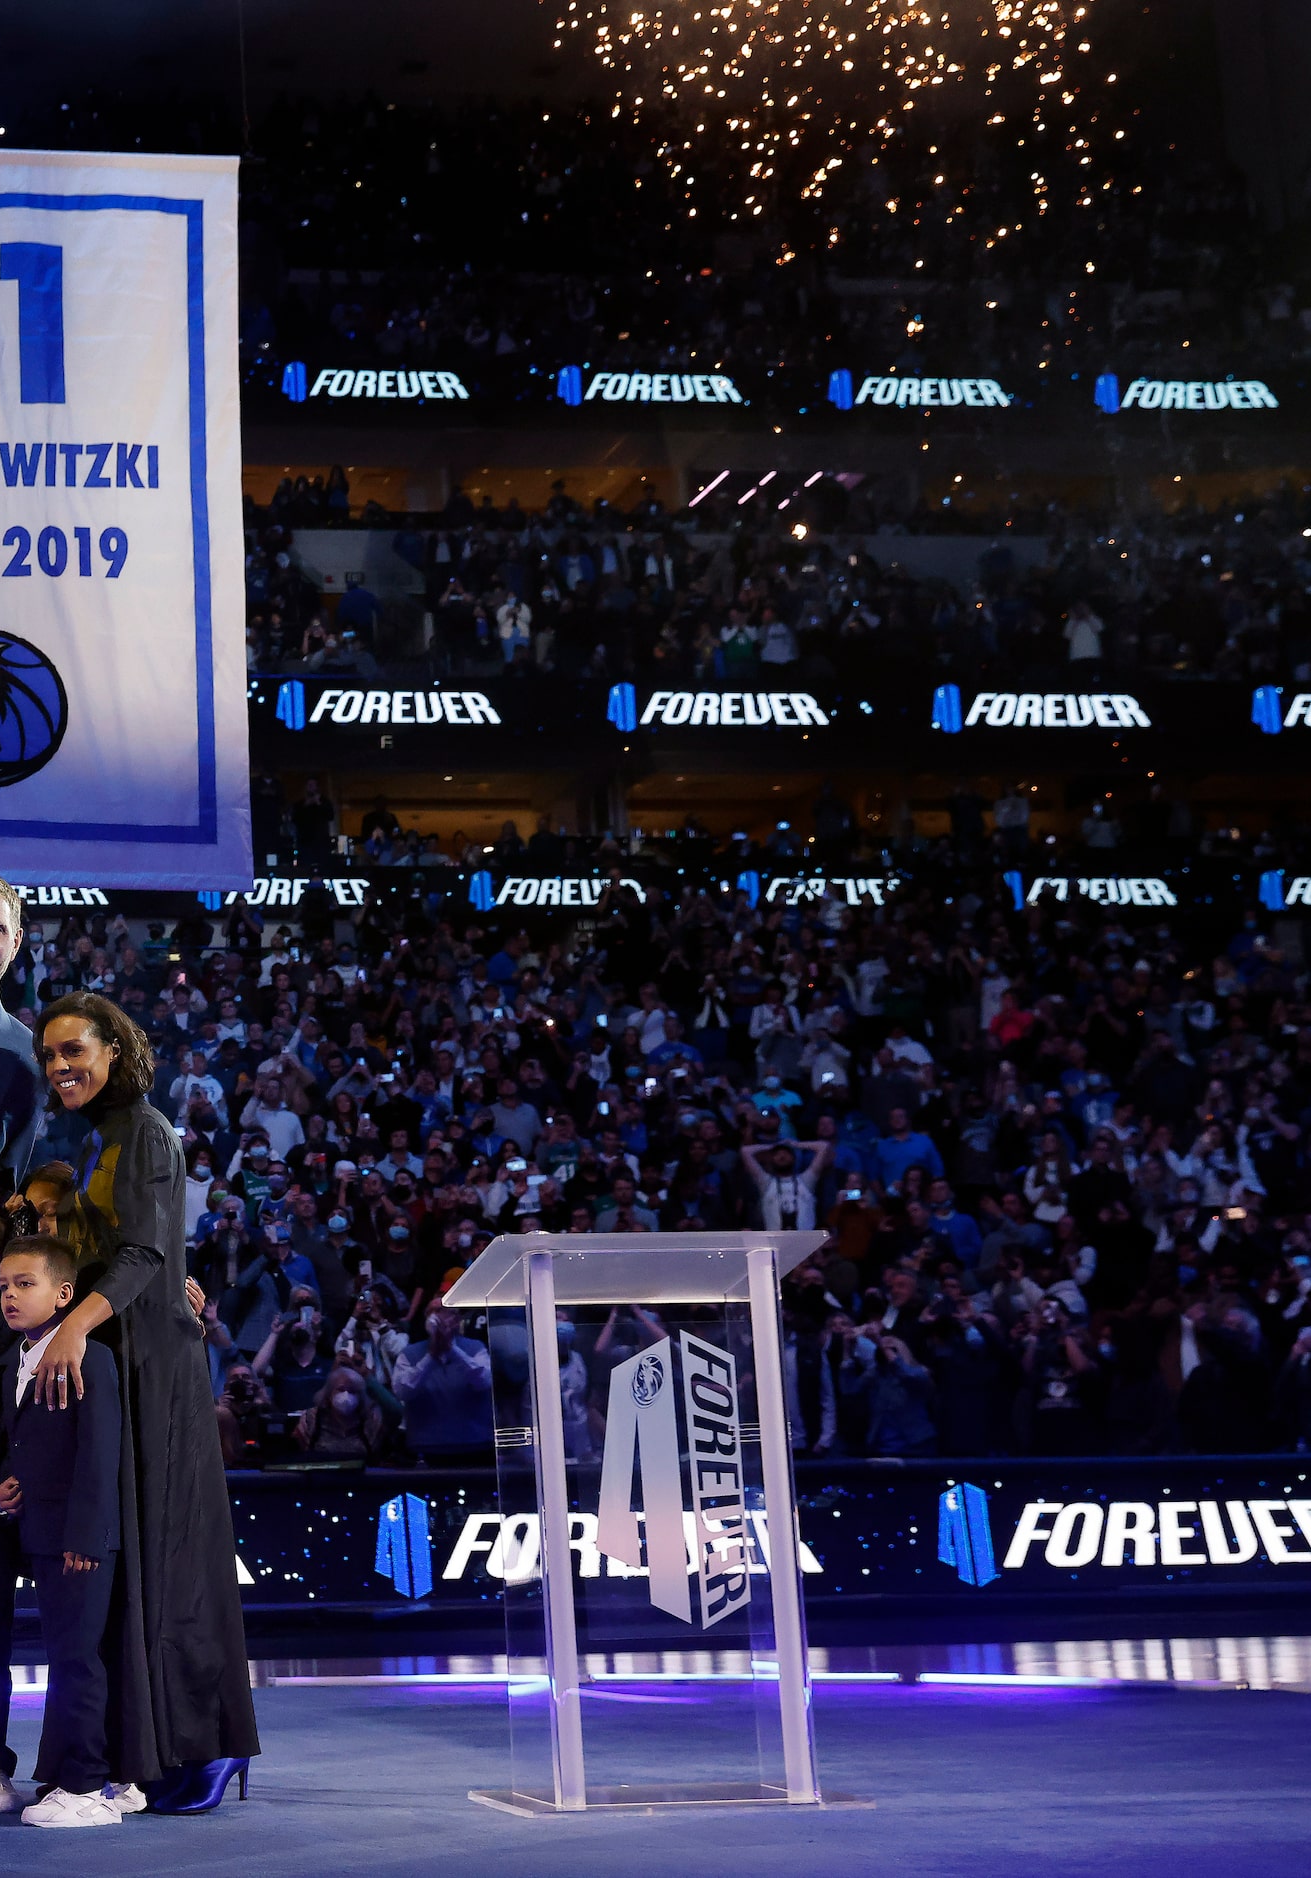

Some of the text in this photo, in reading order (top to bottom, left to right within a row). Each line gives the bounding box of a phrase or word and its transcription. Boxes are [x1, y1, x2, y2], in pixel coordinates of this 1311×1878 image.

[310, 370, 468, 398] FOREVER
[585, 374, 741, 402] FOREVER
[855, 378, 1010, 407] FOREVER
[1122, 381, 1277, 409] FOREVER
[310, 690, 501, 724] FOREVER
[640, 692, 829, 725] FOREVER
[965, 693, 1150, 727] FOREVER
[688, 1341, 747, 1618] FOREVER
